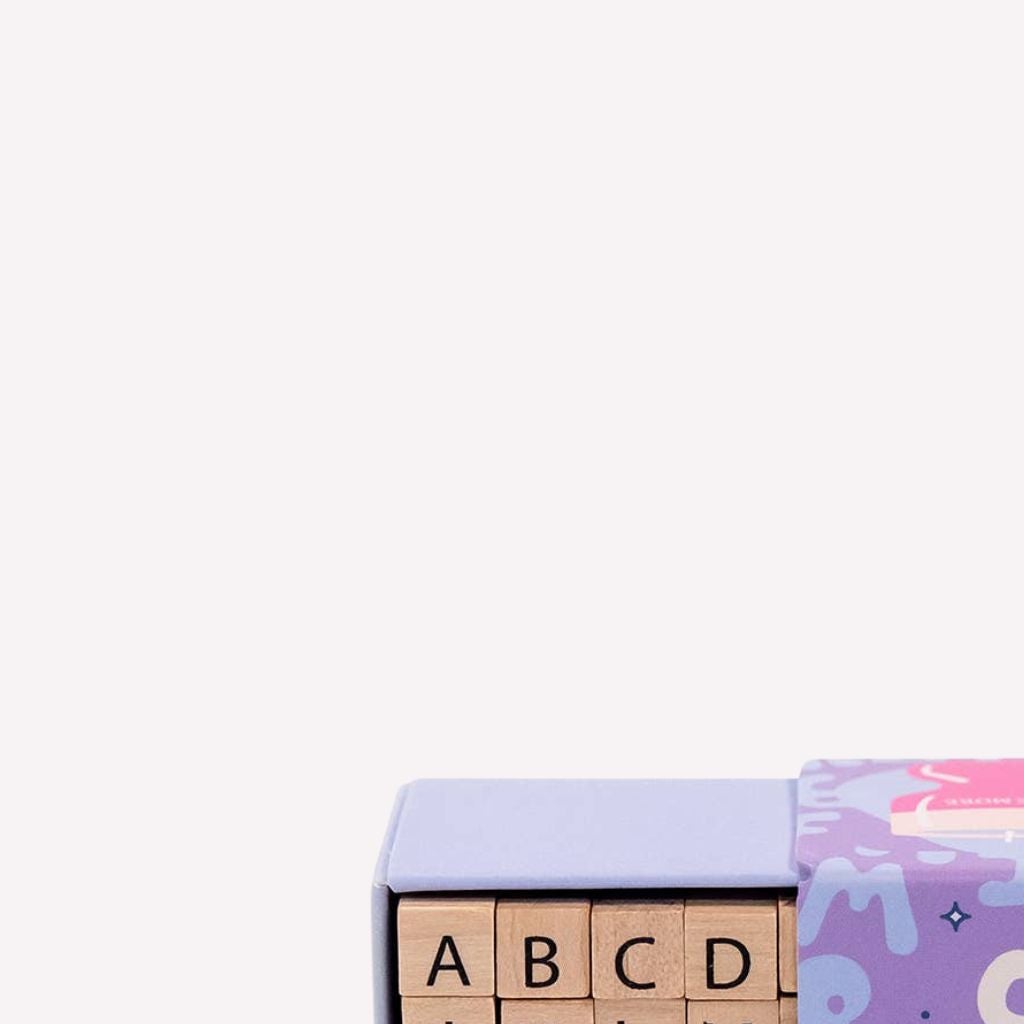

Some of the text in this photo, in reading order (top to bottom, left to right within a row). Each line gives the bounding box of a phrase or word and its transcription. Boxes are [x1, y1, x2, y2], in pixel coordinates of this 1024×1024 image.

[426, 935, 751, 990] A B C D
